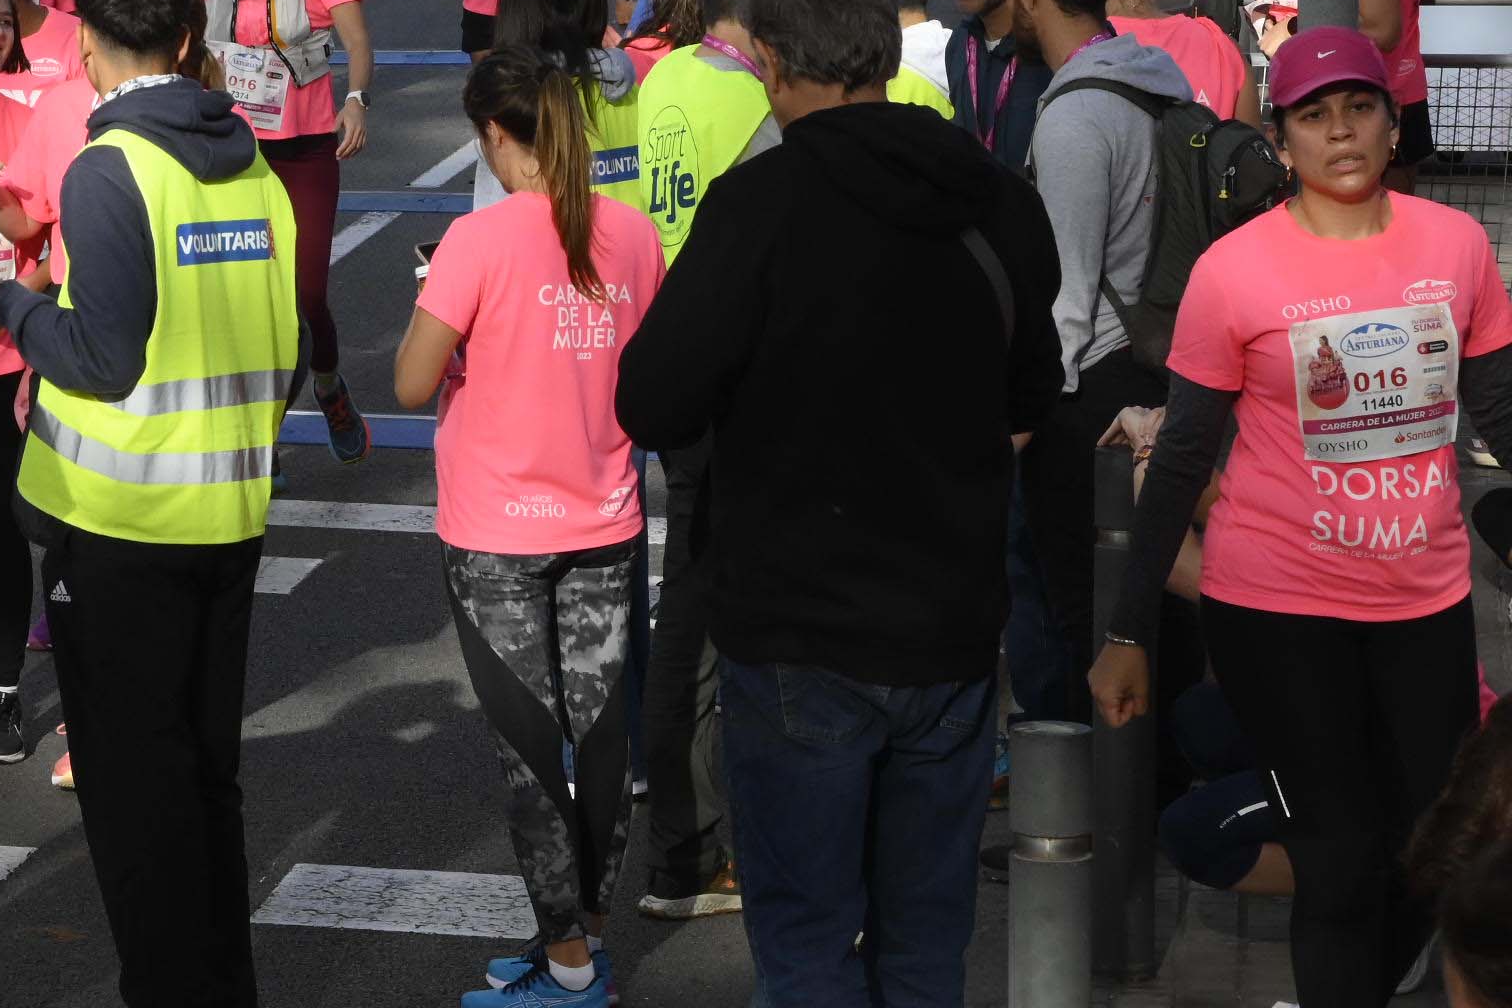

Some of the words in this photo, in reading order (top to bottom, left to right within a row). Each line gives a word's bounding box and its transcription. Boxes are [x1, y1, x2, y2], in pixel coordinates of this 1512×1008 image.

[229, 75, 257, 90] 016
[645, 125, 686, 169] Sport
[649, 160, 696, 223] Life
[558, 306, 579, 328] DE
[587, 305, 614, 326] LA
[1281, 295, 1352, 319] OYSHO
[1413, 321, 1443, 333] SUMA
[553, 327, 616, 350] MUJER
[1345, 336, 1406, 353] ASTURIANA
[1354, 367, 1408, 393] 016
[1361, 394, 1403, 411] 11440
[1320, 419, 1365, 431] CARRERA
[1367, 417, 1381, 426] DE
[1383, 415, 1394, 424] LA
[1396, 410, 1426, 423] MUJER
[1318, 440, 1368, 454] OYSHO
[505, 502, 566, 518] OYSHO
[1311, 511, 1430, 550] SUMA
[50, 593, 71, 603] adidas
